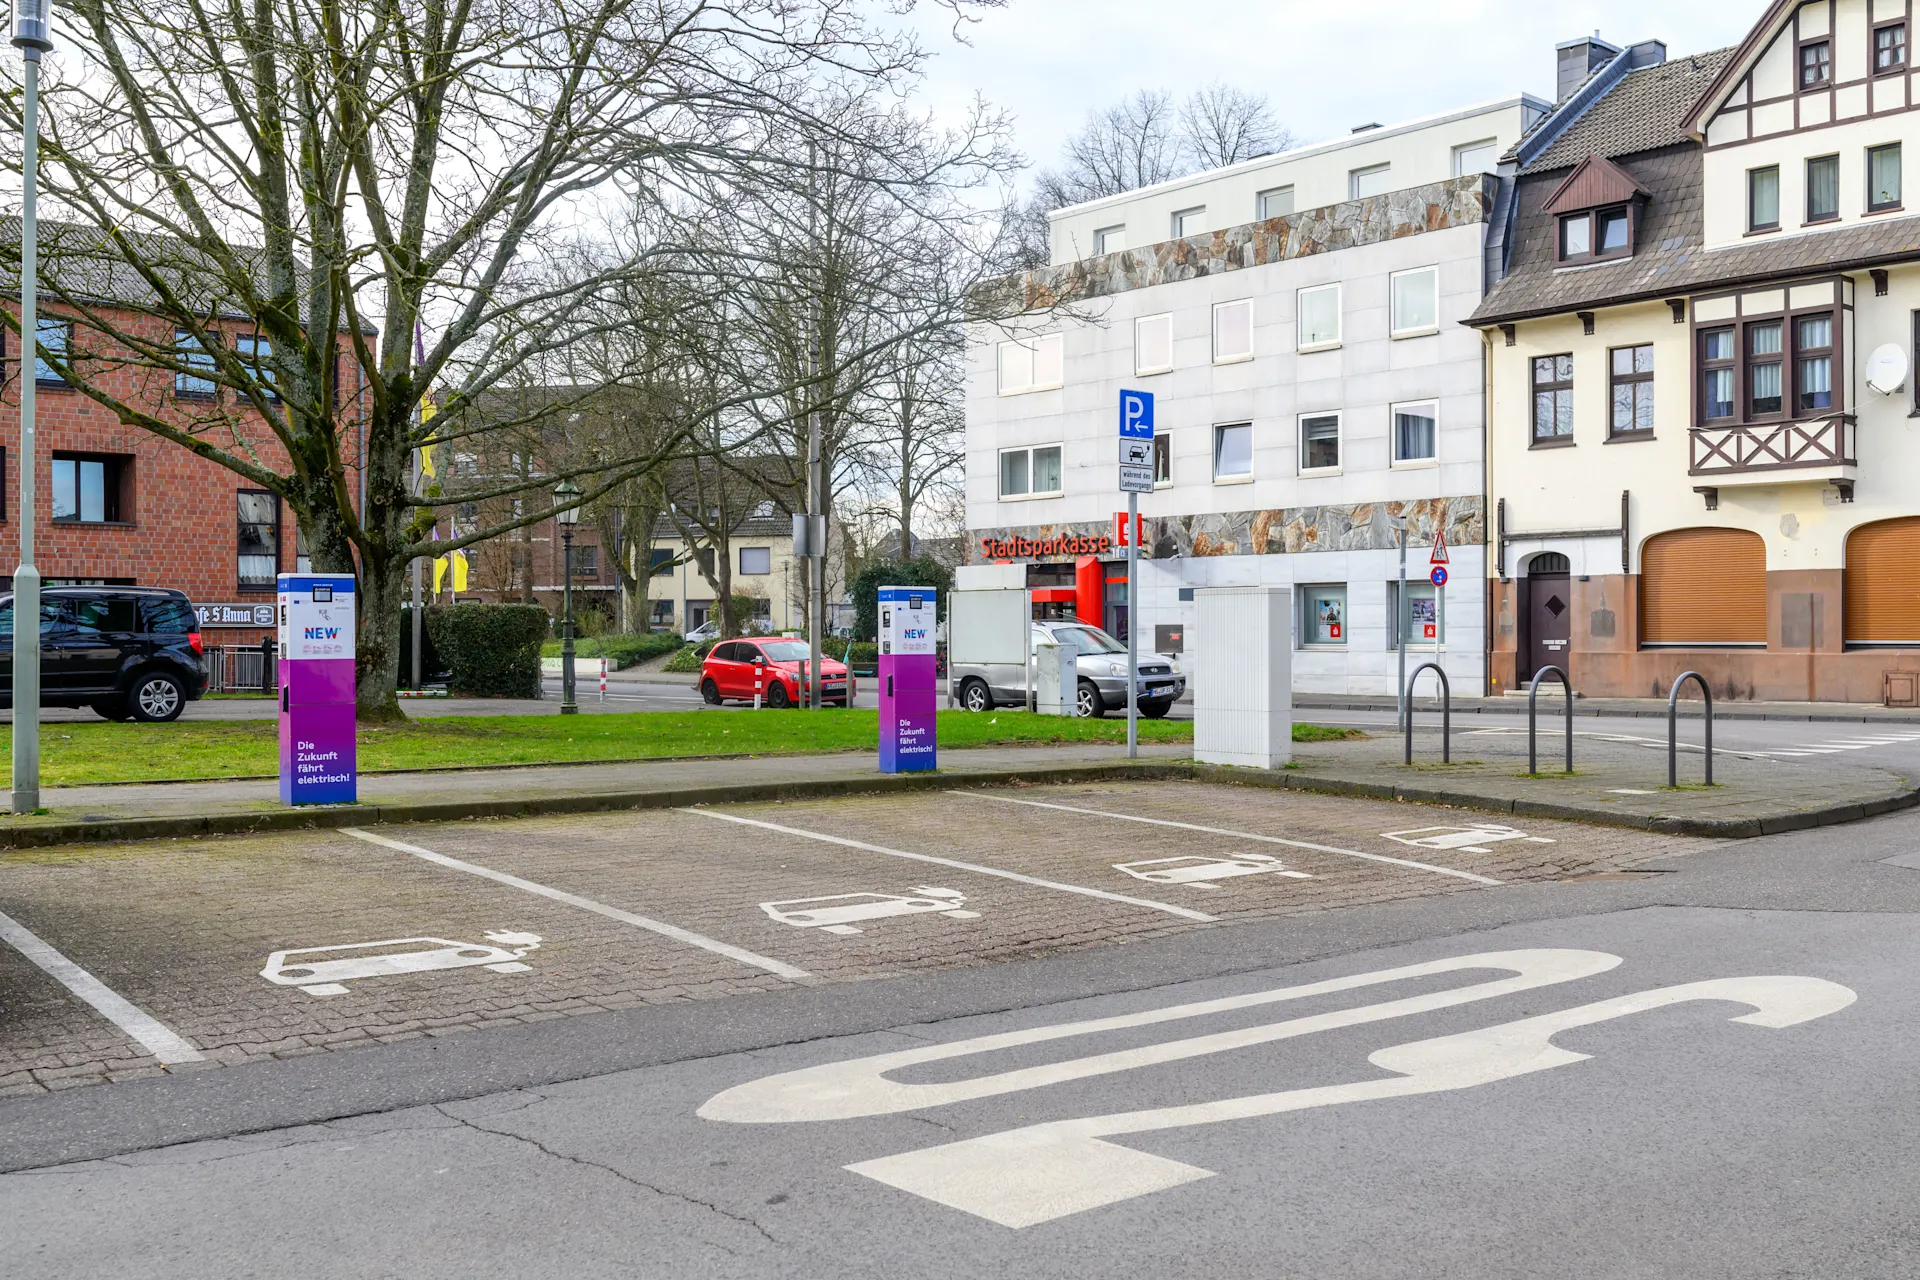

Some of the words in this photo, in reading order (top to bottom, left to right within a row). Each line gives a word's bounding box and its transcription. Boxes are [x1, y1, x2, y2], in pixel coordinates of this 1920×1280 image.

[1125, 395, 1144, 432] P
[1123, 470, 1142, 479] während
[1143, 471, 1151, 480] des
[1122, 479, 1152, 490] Ladevorgangs
[980, 532, 1109, 560] Stadtsparkasse
[304, 627, 339, 640] NEW
[904, 628, 926, 639] NEW
[899, 719, 911, 727] Die
[899, 728, 926, 736] Zukunft
[297, 741, 315, 750] Die
[899, 737, 917, 745] fährt
[899, 745, 933, 754] elektrisch!
[297, 751, 338, 762] Zukunft
[297, 763, 324, 773] fährt
[297, 773, 350, 785] elektrisch!
